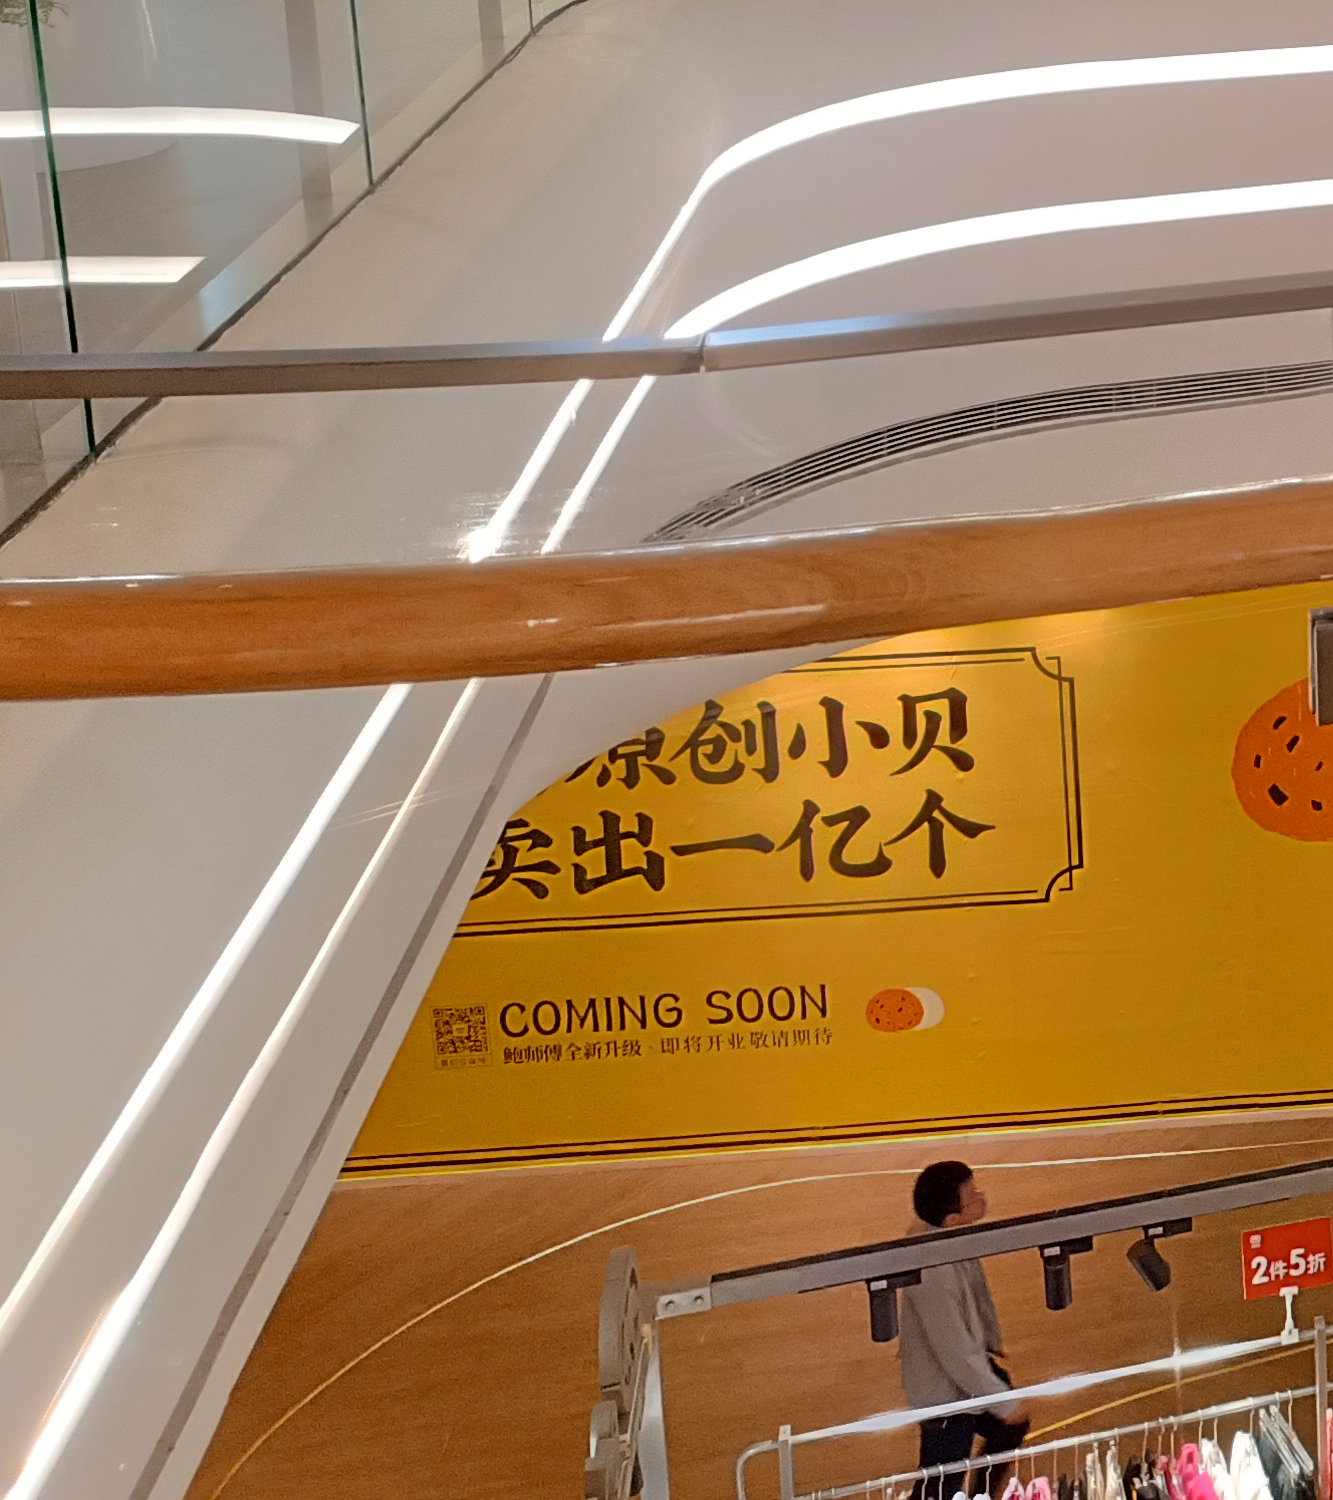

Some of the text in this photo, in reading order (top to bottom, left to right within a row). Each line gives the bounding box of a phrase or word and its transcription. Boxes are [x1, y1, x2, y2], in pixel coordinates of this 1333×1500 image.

[536, 686, 975, 798] 原创小贝
[472, 788, 996, 900] 卖出一亿个
[499, 983, 828, 1038] COMING SOON
[1250, 1247, 1326, 1286] 2件5折
